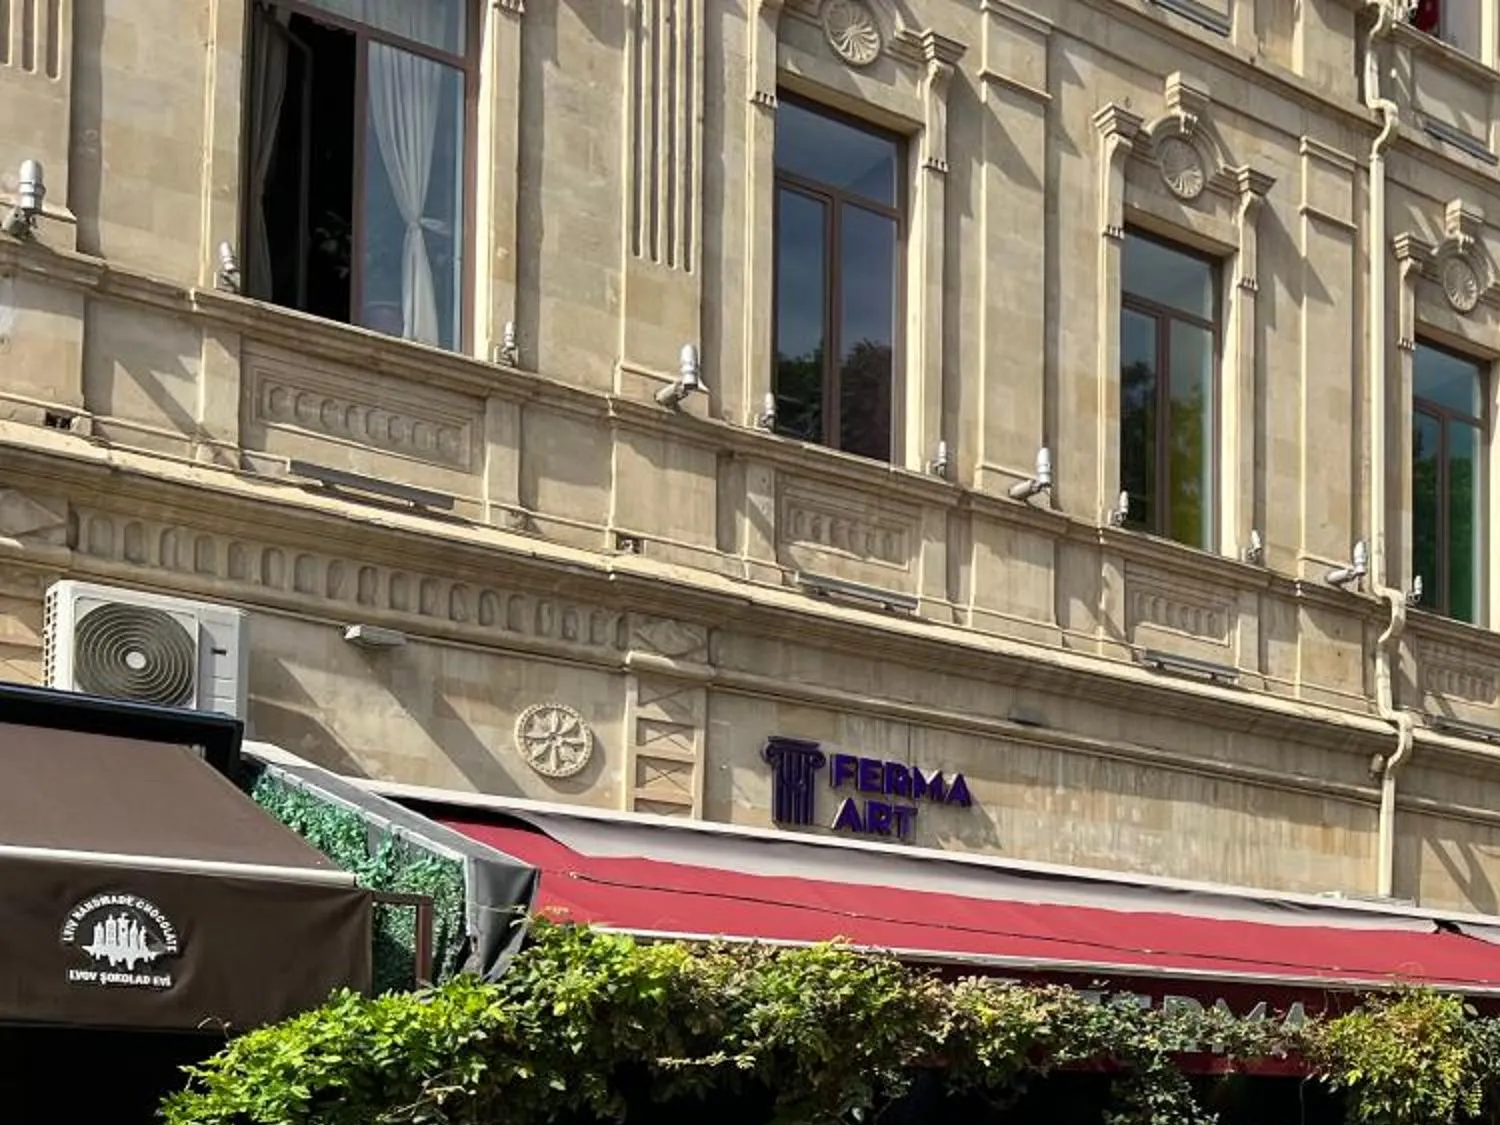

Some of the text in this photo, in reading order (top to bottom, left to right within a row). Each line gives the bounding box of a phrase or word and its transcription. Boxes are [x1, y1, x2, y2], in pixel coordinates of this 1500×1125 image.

[831, 753, 972, 807] FERMA
[831, 797, 918, 837] ART
[72, 895, 135, 920] HANDMADE
[136, 901, 177, 952] CHOCOLATE
[100, 971, 151, 985] ŞOKOLAD
